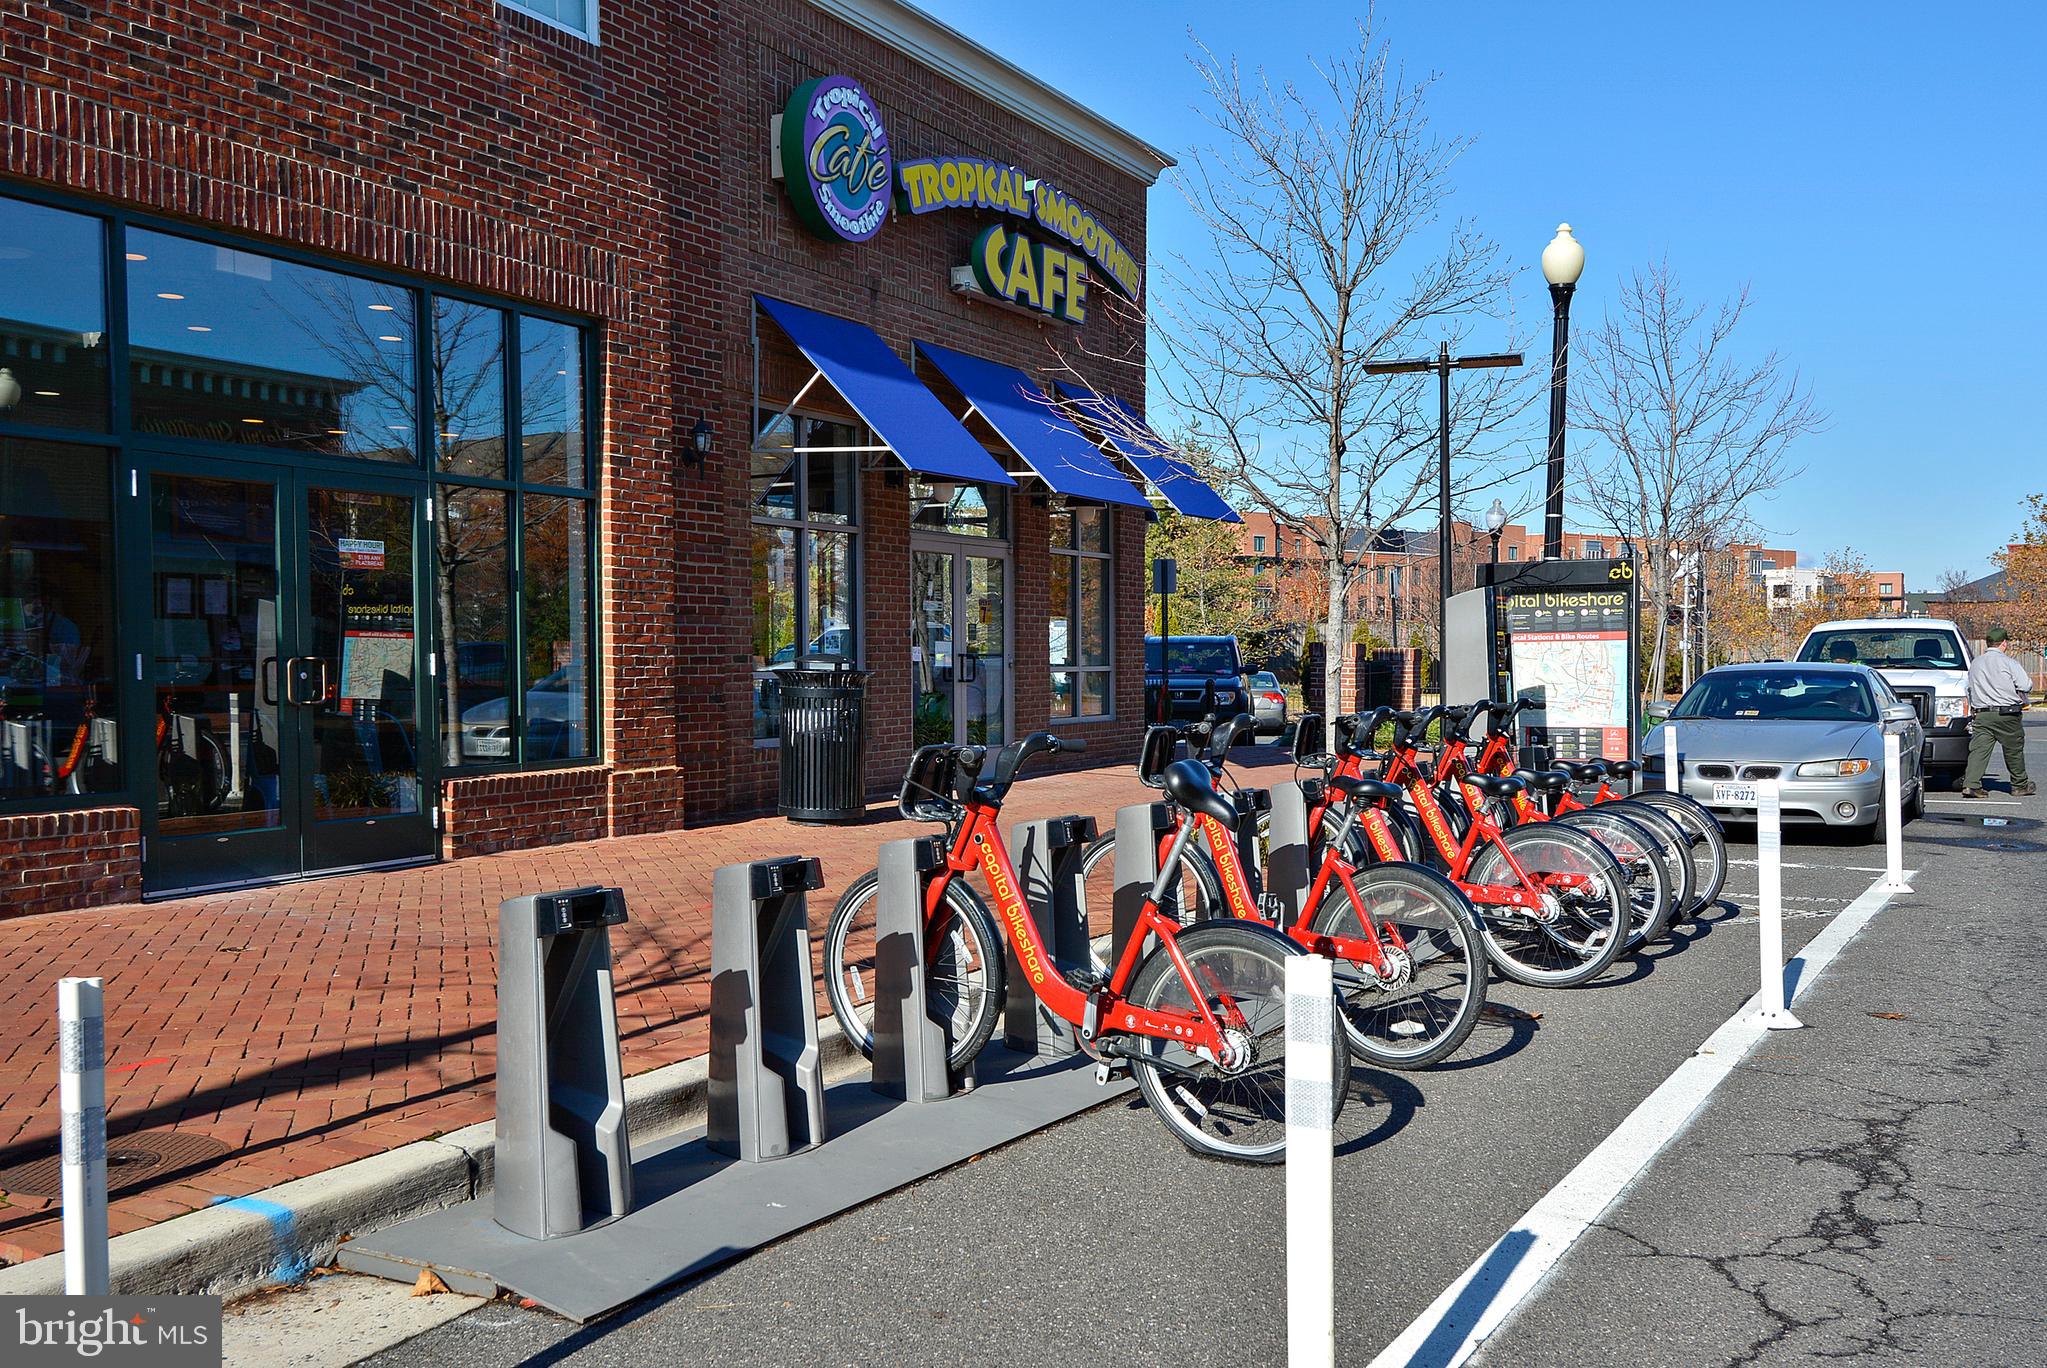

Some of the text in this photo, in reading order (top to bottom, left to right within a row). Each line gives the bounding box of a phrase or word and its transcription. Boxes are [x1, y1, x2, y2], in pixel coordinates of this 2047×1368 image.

[811, 86, 883, 140] Tropical
[809, 124, 889, 194] Café
[818, 183, 885, 235] Smoothie
[903, 161, 1141, 290] TROPICAL SMOOTHIE
[984, 225, 1088, 321] CAFE
[340, 540, 362, 548] HAPPY
[1545, 592, 1625, 608] bikeshare
[1715, 790, 1755, 801] XVF-8272
[1426, 807, 1455, 859] bikeshare
[1219, 851, 1247, 919] bikeshare
[981, 842, 1044, 984] capital bikeshare
